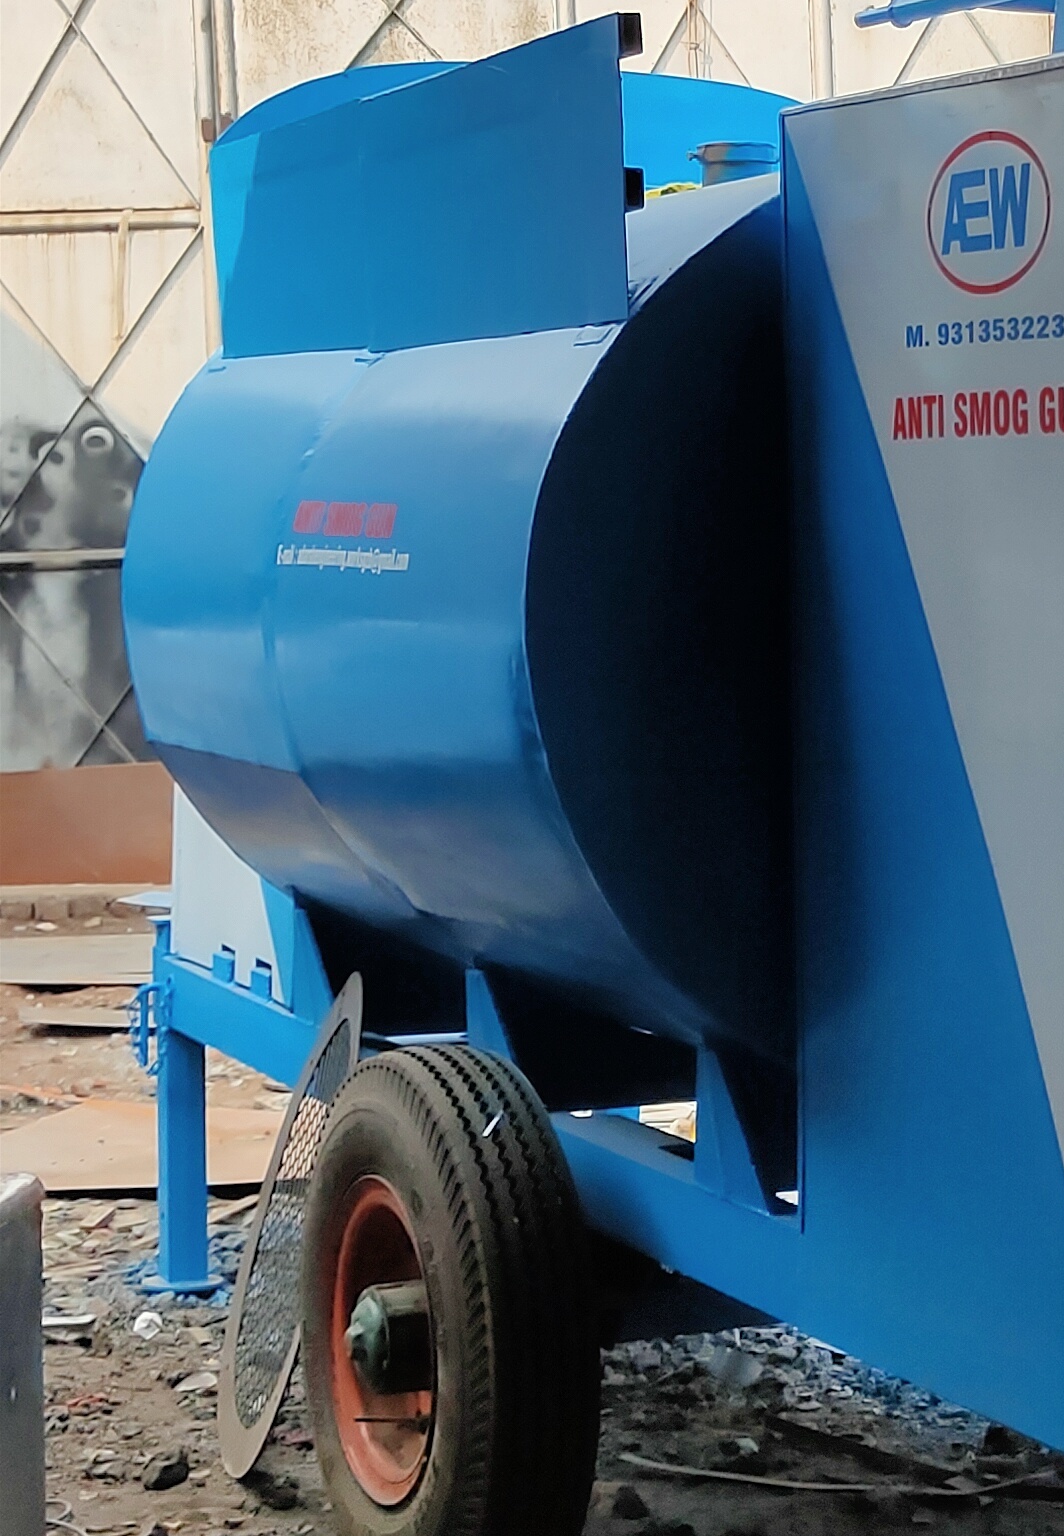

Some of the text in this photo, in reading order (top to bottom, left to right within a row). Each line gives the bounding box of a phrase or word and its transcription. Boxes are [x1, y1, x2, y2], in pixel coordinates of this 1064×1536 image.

[905, 325, 929, 348] M.
[893, 395, 945, 440] ANTI
[954, 388, 1029, 437] SMOG
